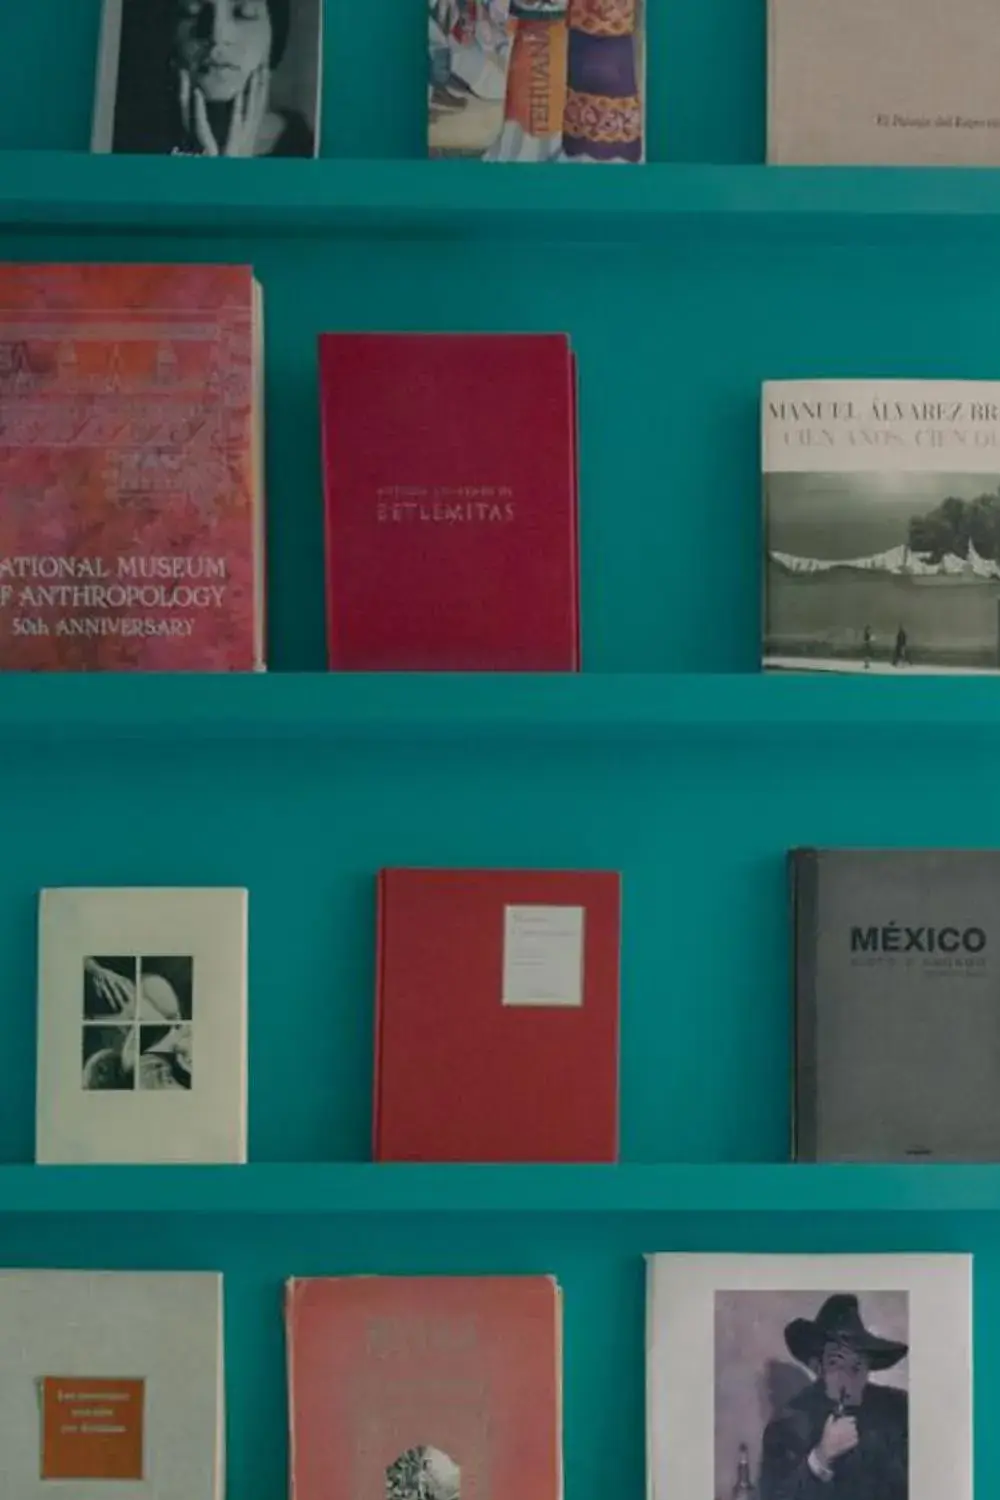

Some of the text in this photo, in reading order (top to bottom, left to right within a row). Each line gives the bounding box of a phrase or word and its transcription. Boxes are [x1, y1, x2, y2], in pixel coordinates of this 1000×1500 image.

[769, 400, 857, 421] MANUEL
[0, 556, 226, 579] ATIONAL MUSEUM
[19, 585, 227, 608] ANTHROPOLOGY
[12, 618, 196, 637] 50th ANNIVERSARY
[850, 920, 987, 953] MÉXICO
